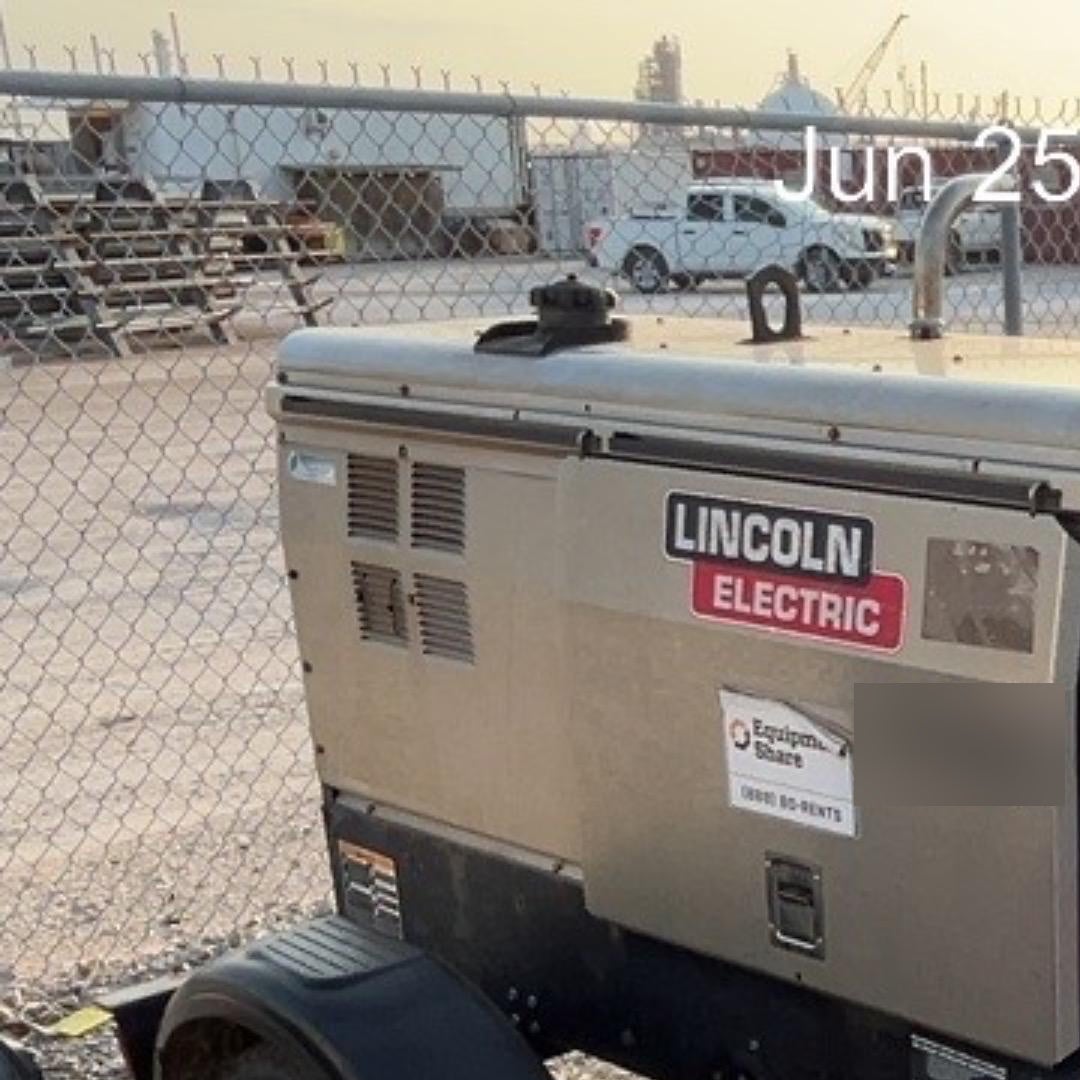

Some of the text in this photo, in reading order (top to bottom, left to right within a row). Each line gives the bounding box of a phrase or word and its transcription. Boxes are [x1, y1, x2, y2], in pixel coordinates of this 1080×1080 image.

[674, 503, 862, 577] LINCOLN
[713, 575, 881, 637] ELECTRIC
[755, 740, 804, 769] Share
